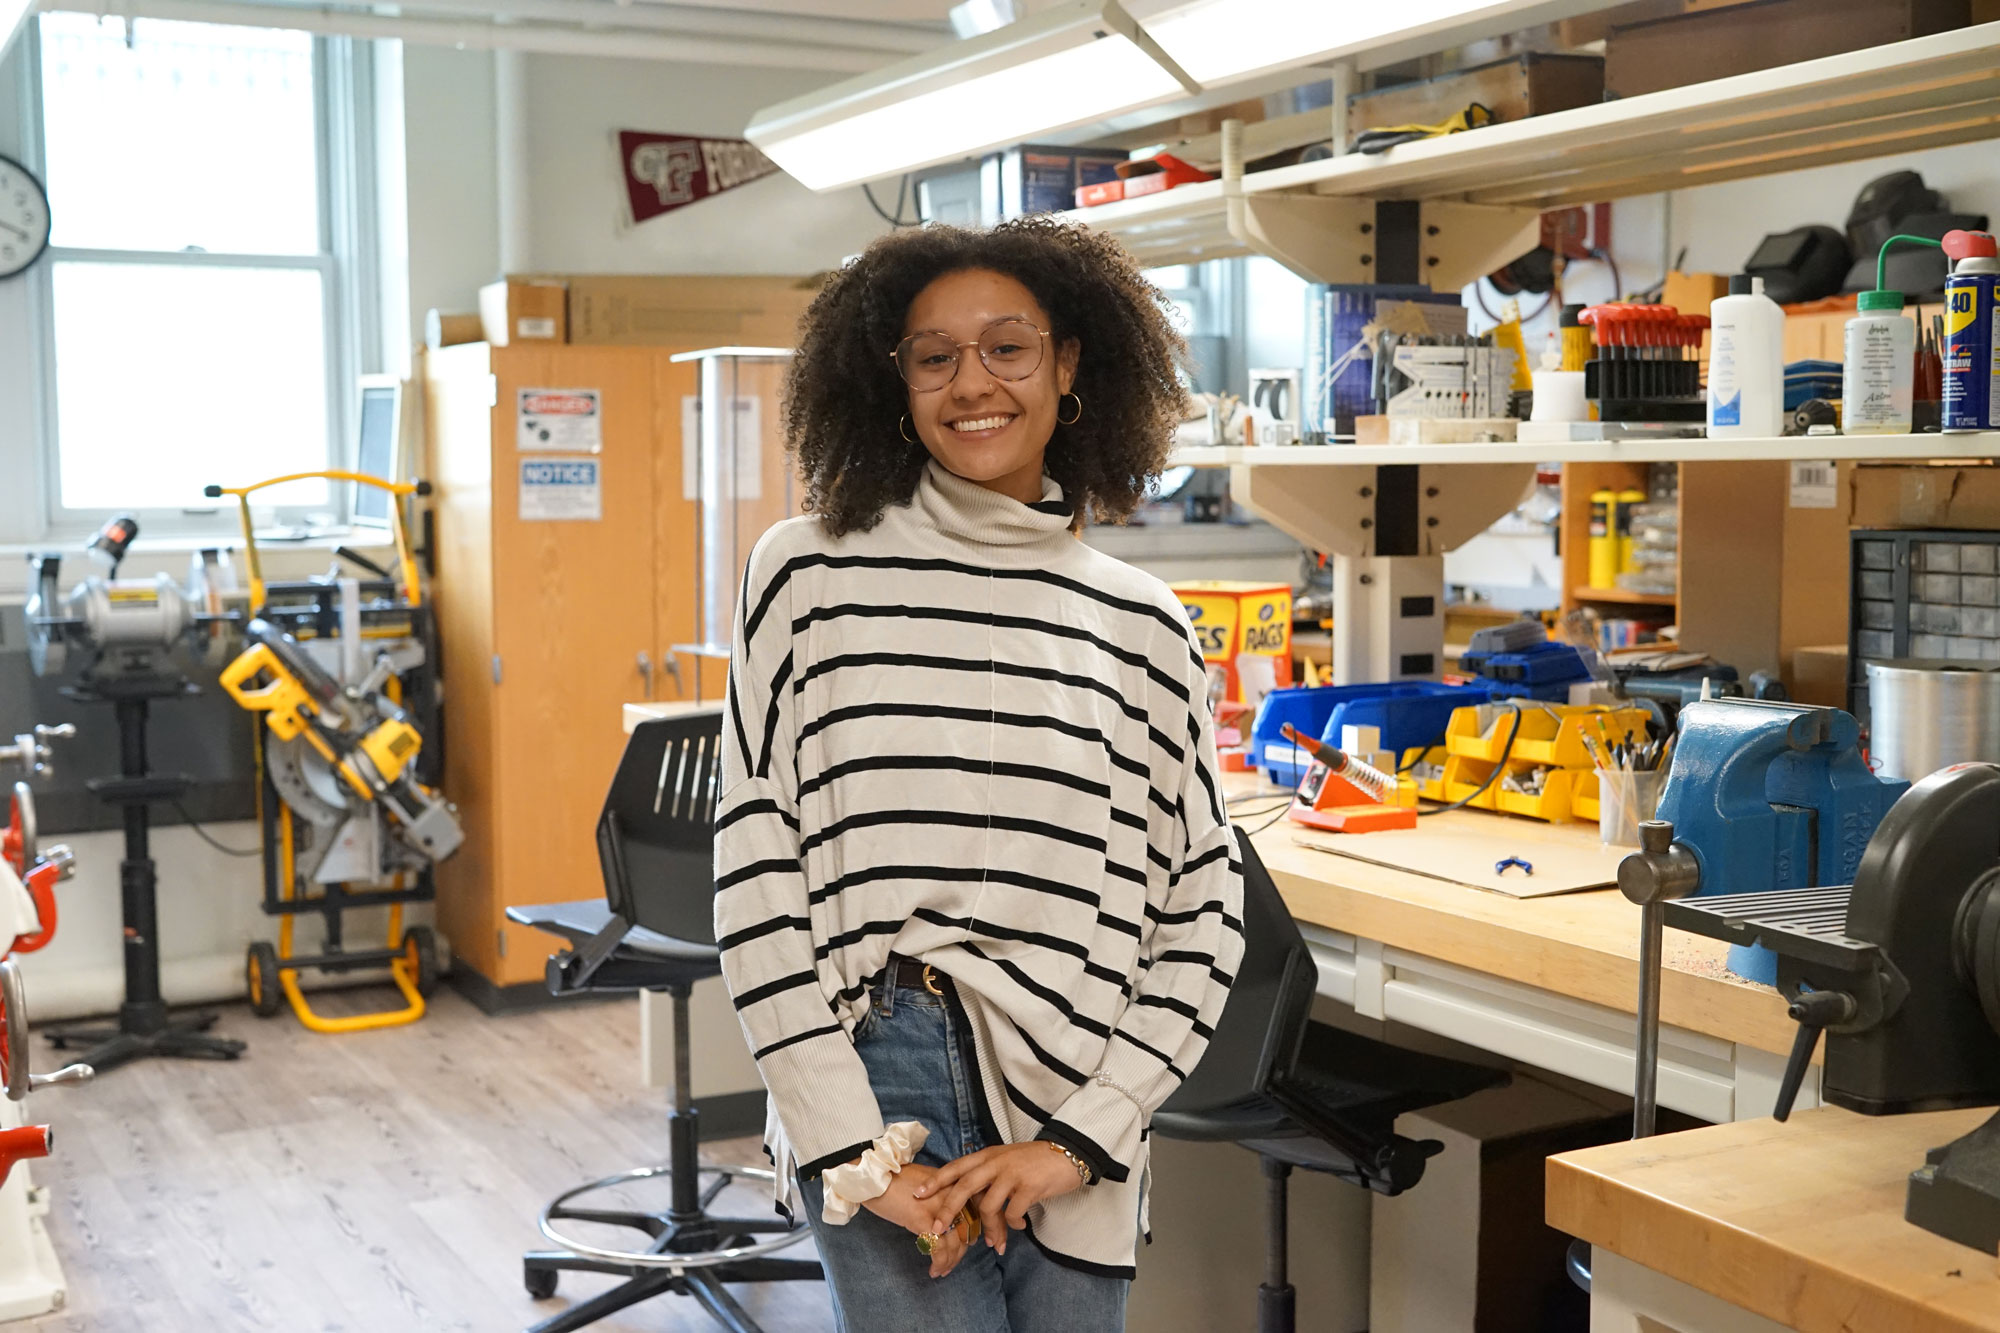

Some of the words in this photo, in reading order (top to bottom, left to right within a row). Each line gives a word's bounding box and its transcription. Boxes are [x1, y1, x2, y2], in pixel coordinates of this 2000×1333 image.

[1944, 292, 1971, 314] -40
[525, 466, 594, 482] NOTICE
[1194, 626, 1226, 653] GS
[1244, 622, 1285, 652] RAGS
